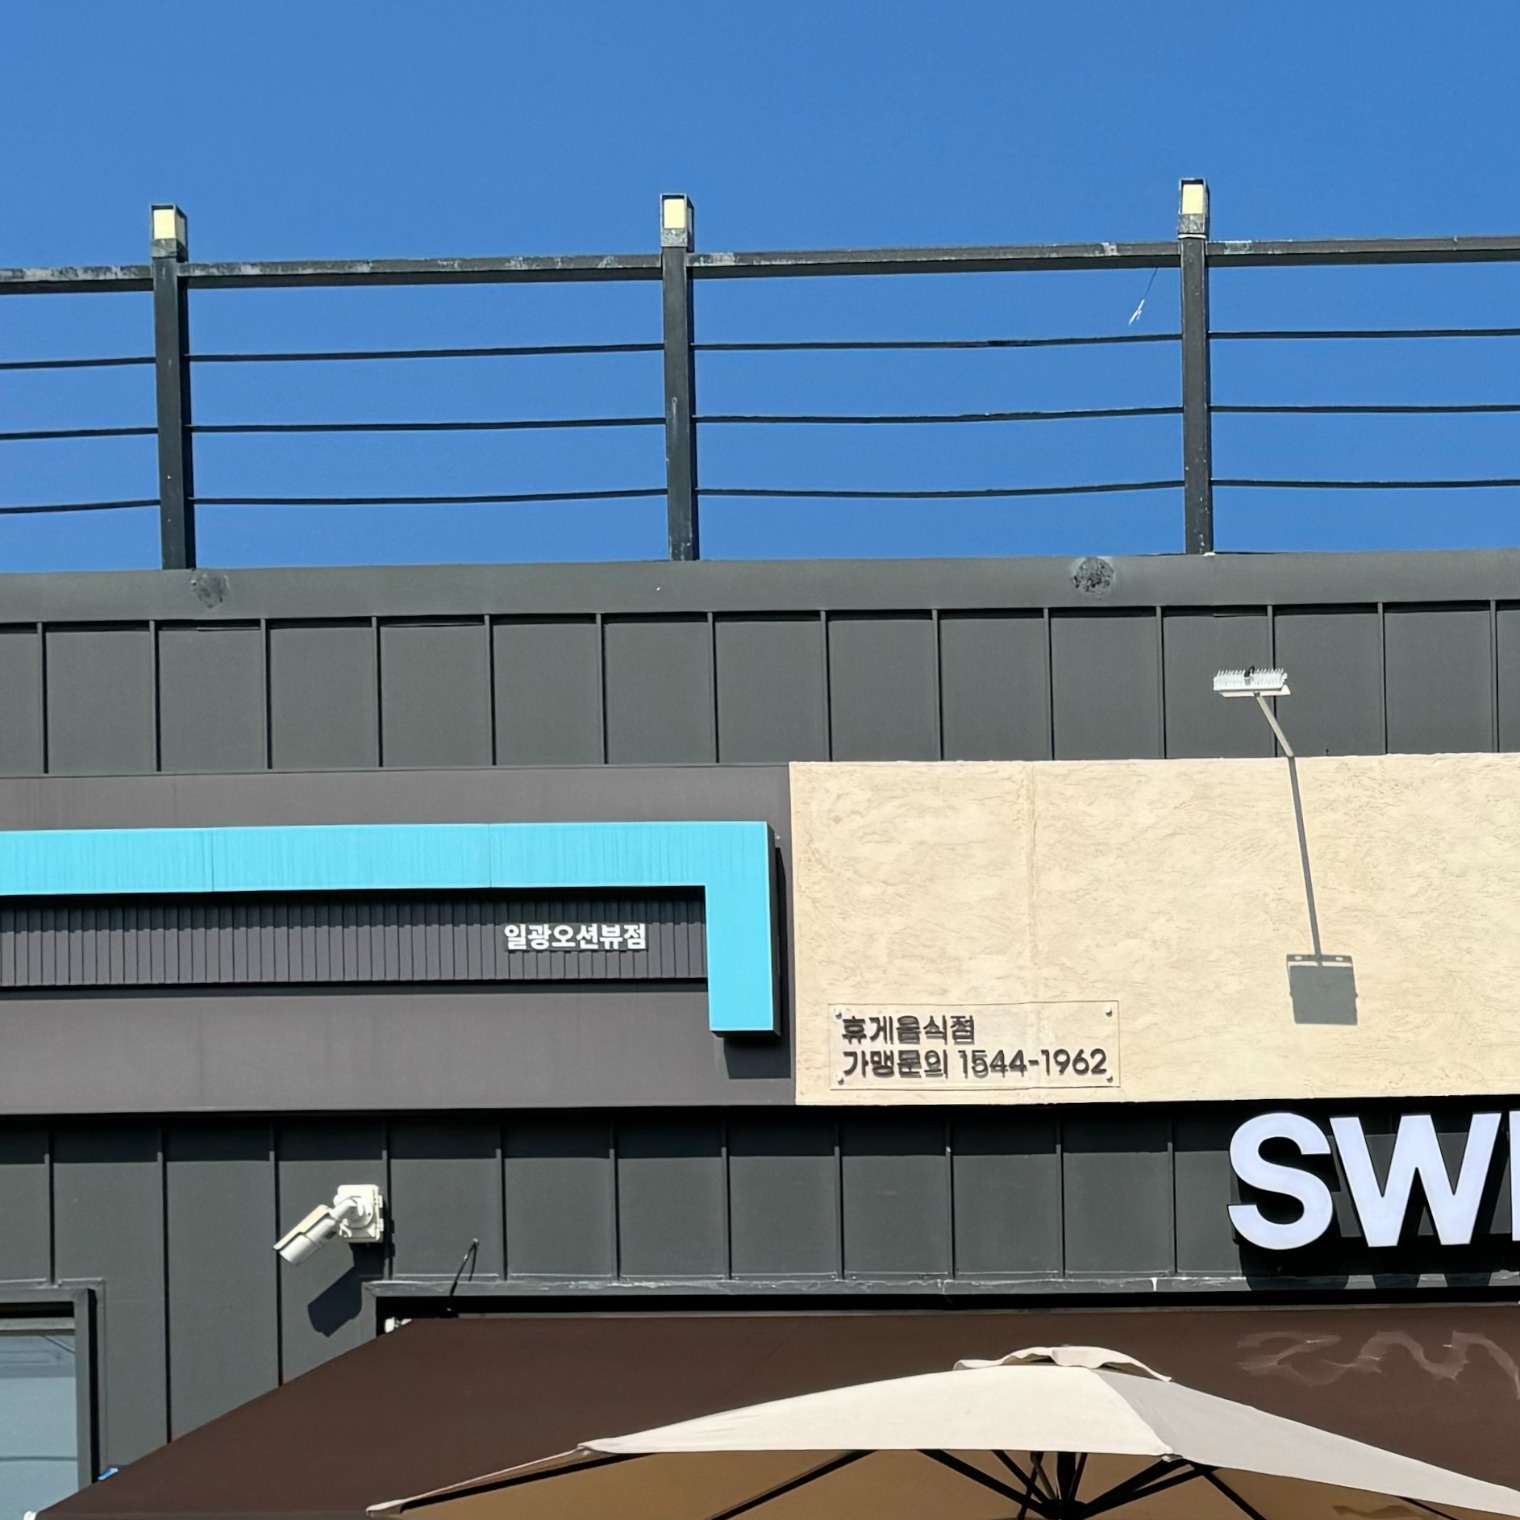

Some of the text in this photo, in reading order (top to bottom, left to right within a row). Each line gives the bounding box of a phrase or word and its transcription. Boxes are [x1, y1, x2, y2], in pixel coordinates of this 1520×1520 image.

[504, 923, 646, 950] 일광오션뷰점
[842, 1015, 975, 1044] 휴게음식점
[843, 1047, 1107, 1078] 가맹문의 1544-1962
